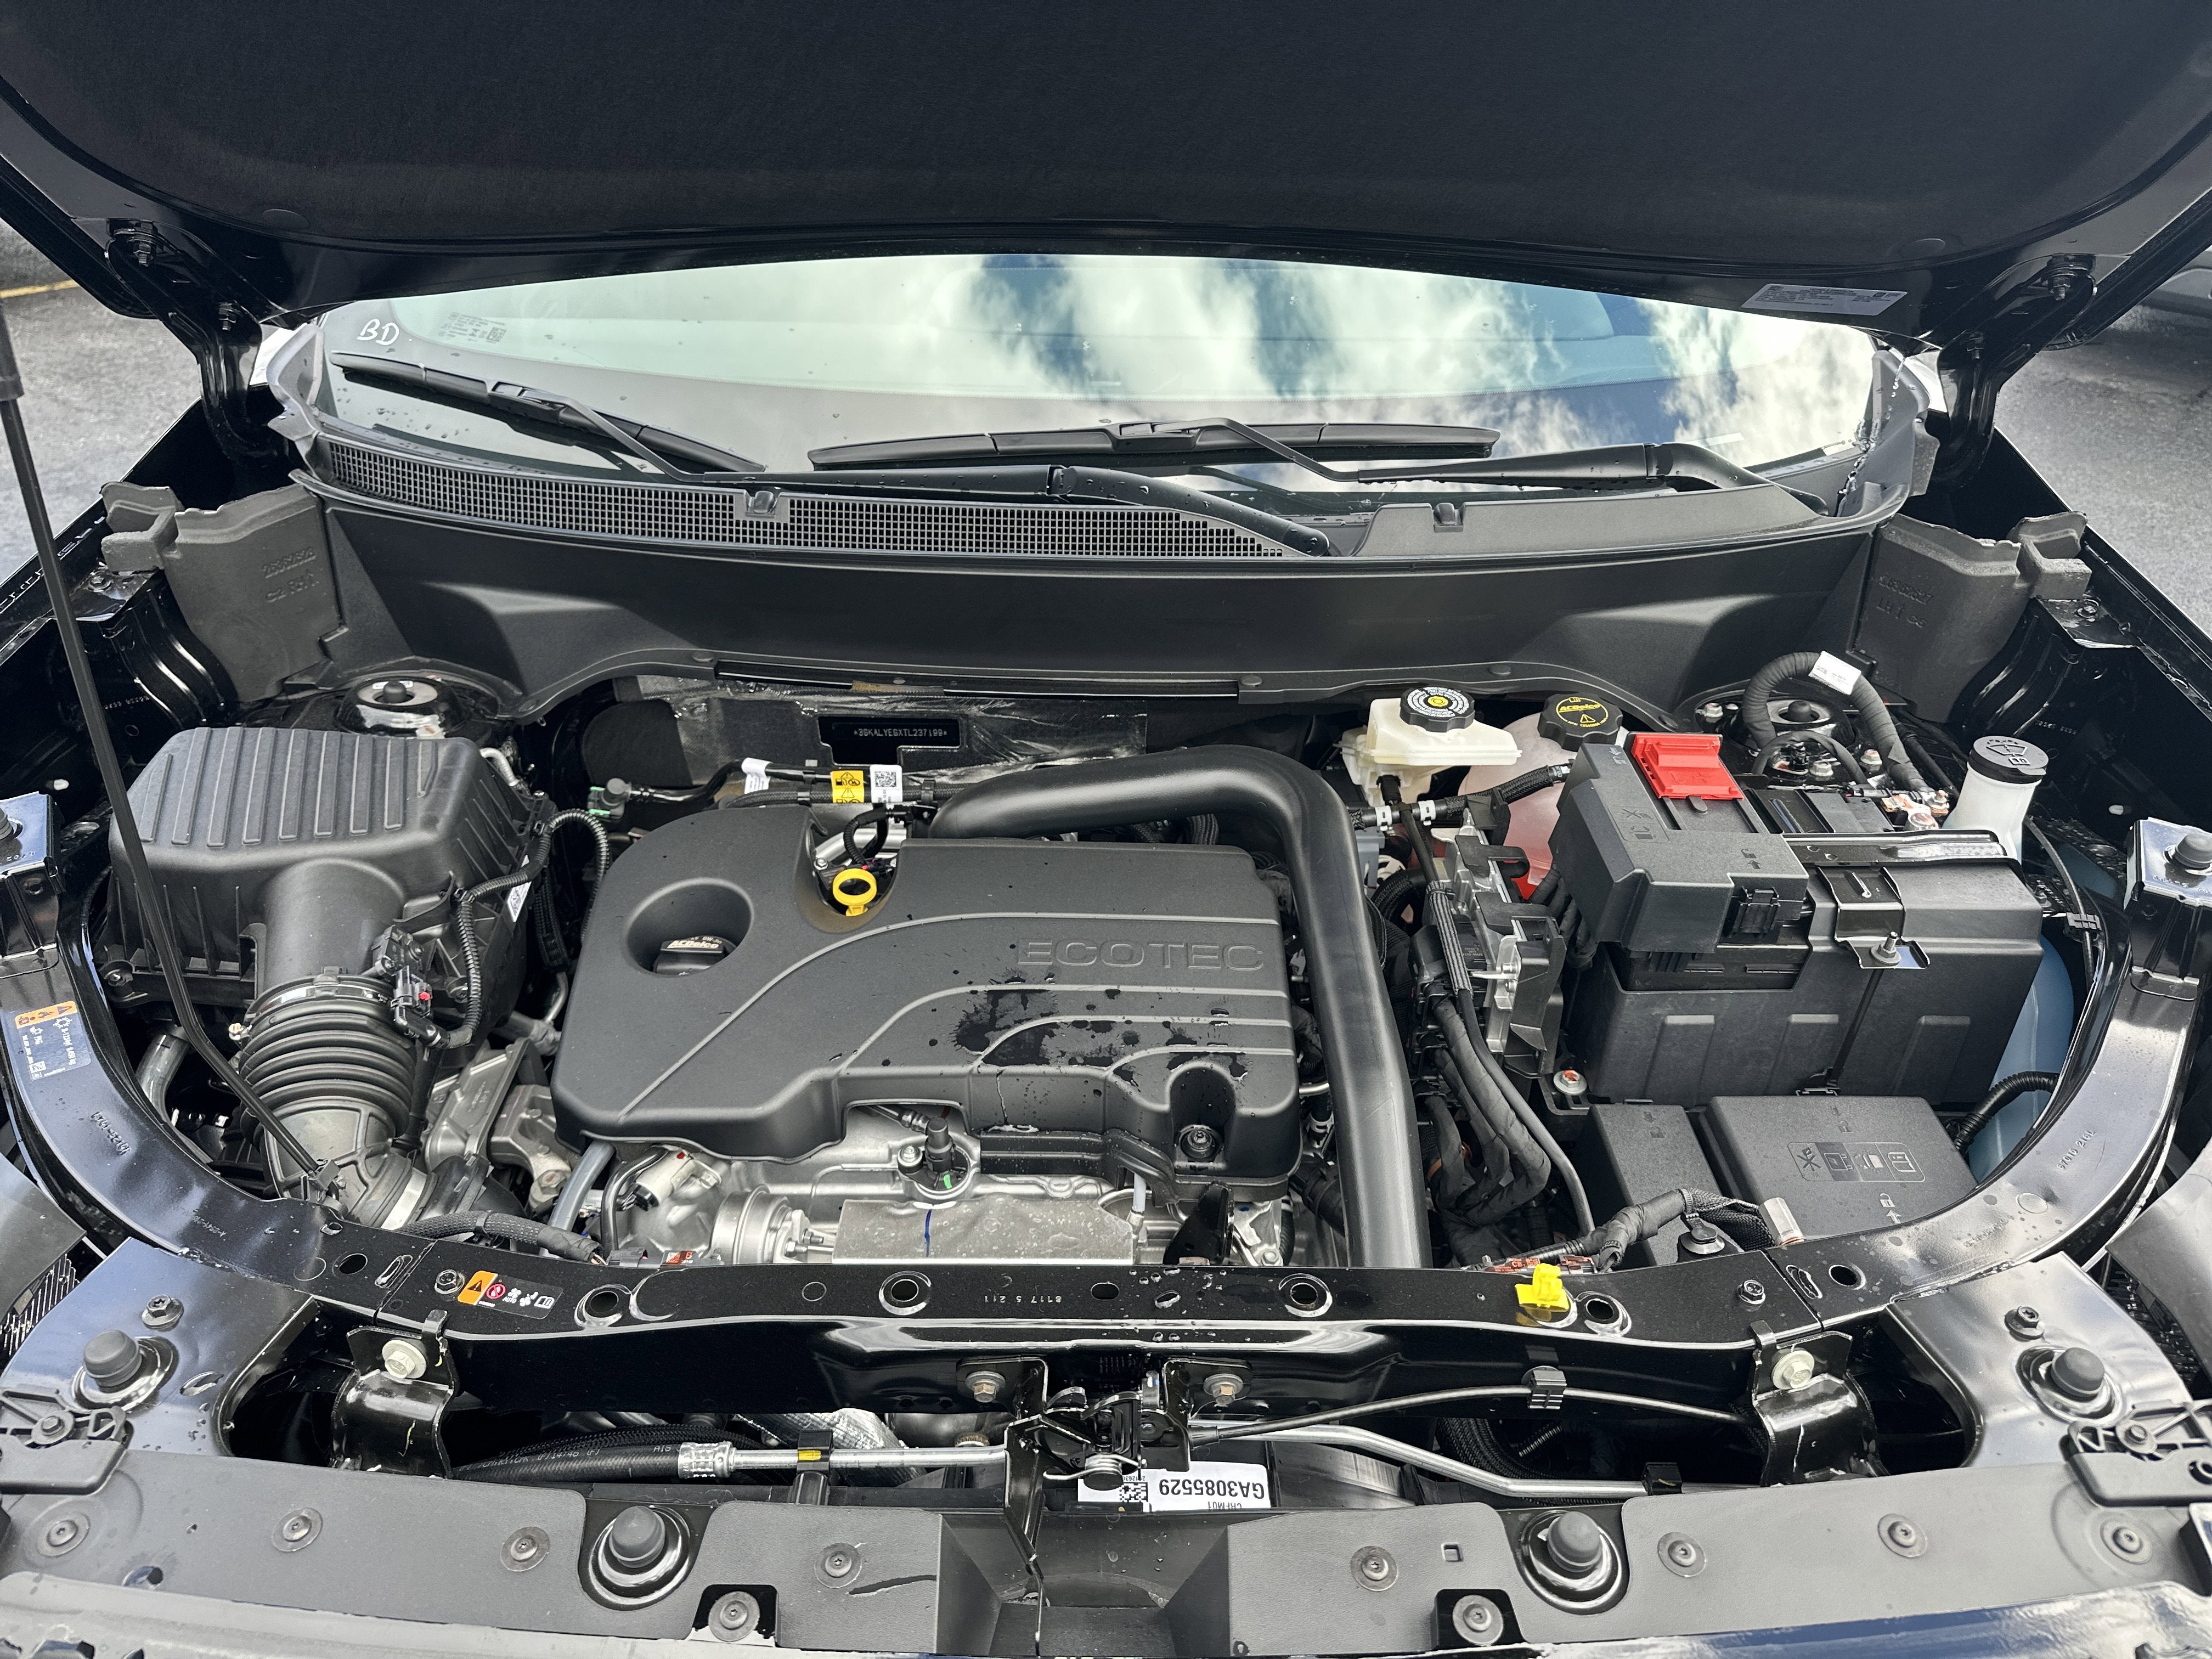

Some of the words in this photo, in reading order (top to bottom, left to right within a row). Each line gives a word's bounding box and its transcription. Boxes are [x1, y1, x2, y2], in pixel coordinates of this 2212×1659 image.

[357, 318, 399, 346] BD
[1560, 704, 1601, 713] ACDelco
[667, 940, 719, 949] ACDelco
[1017, 938, 1264, 971] ECOTEC
[502, 1296, 517, 1304] AUTO
[1159, 1479, 1265, 1499] GA3085529
